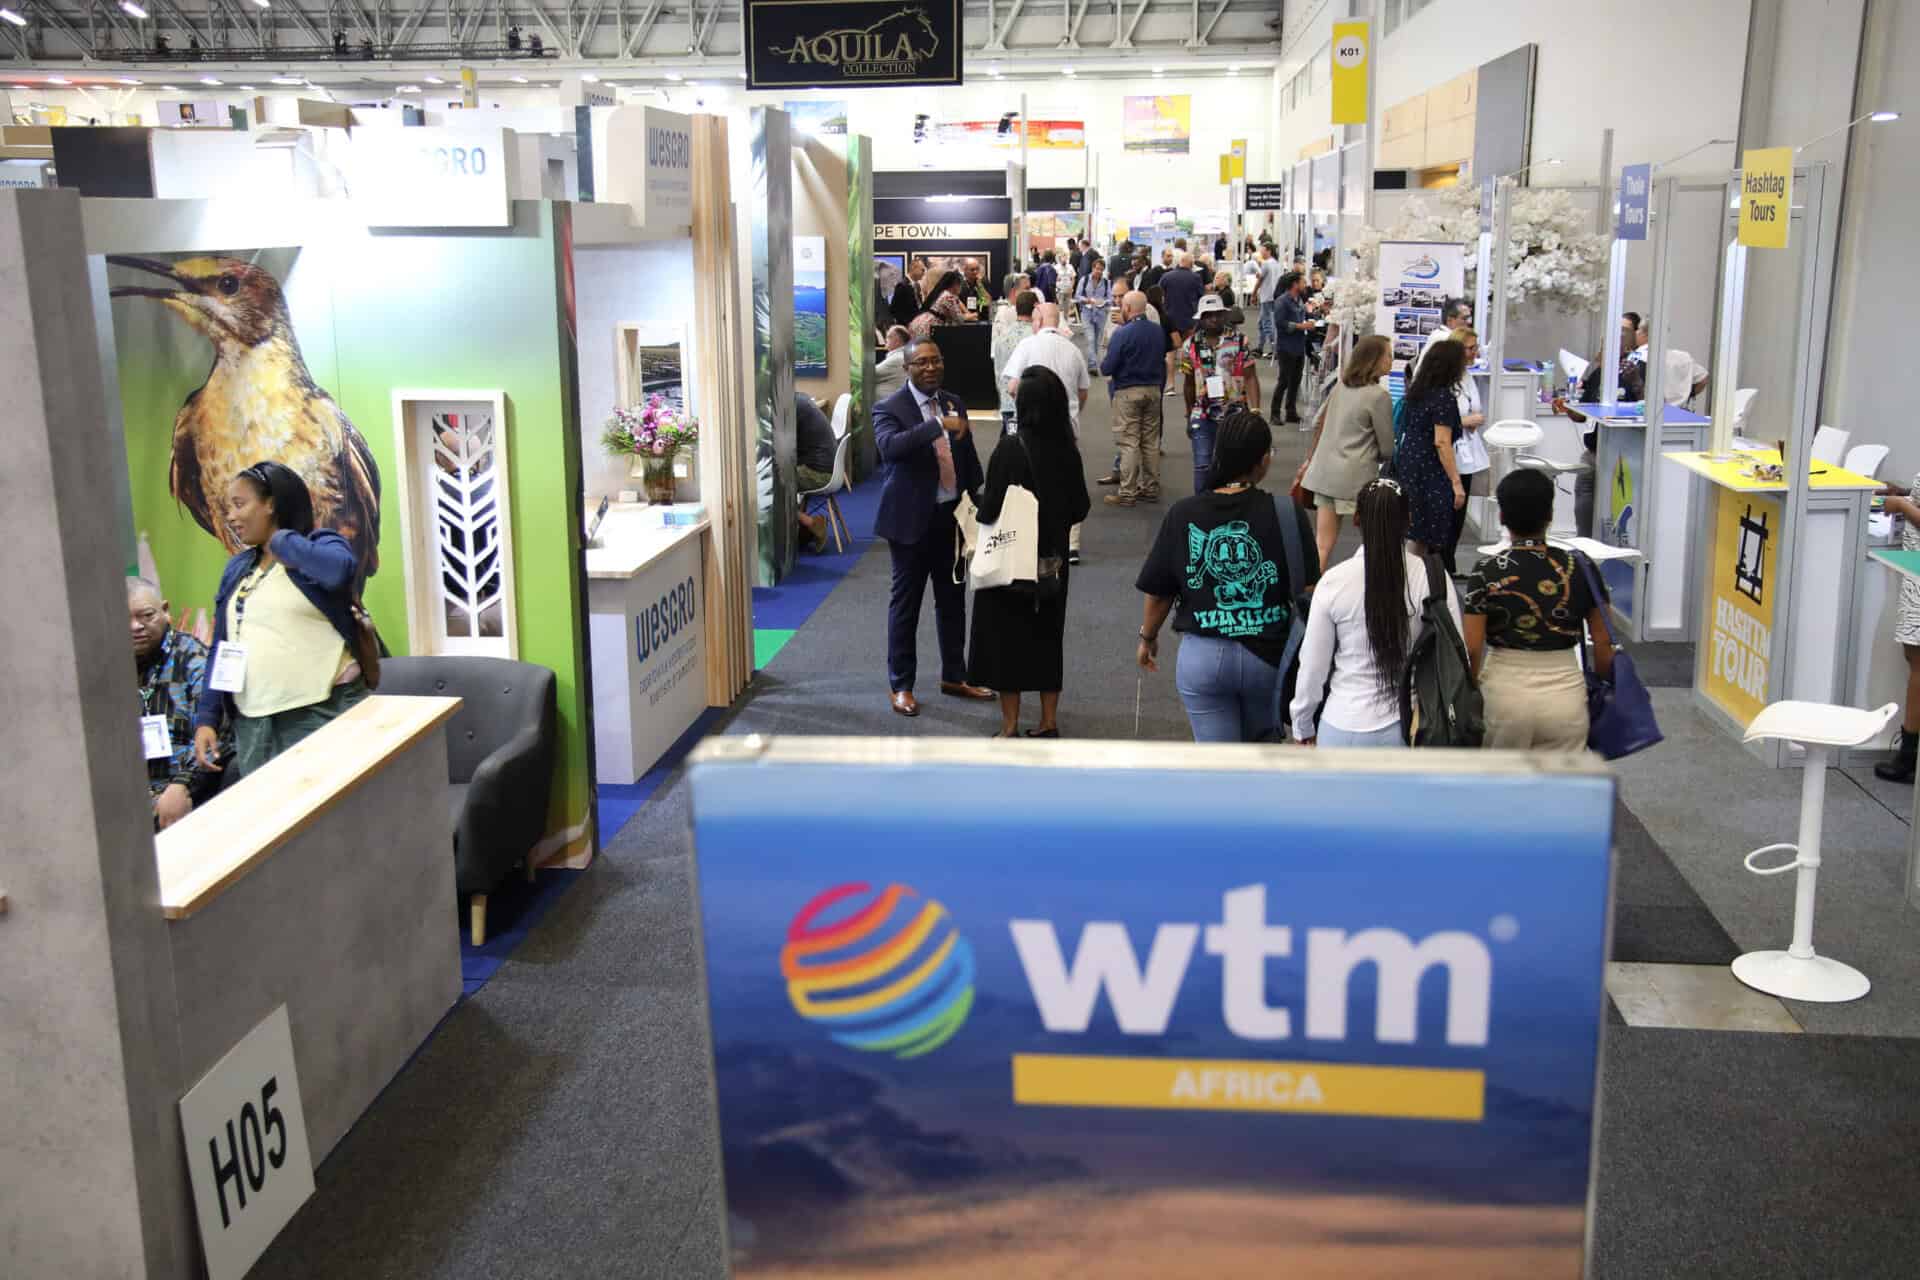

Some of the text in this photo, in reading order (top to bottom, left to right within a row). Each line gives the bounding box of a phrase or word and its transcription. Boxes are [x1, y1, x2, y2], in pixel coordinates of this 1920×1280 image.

[788, 32, 915, 66] AQUILA
[1340, 47, 1359, 57] K01
[842, 63, 916, 75] COLLECTION
[1745, 170, 1785, 199] Hashtag
[1624, 203, 1644, 225] Tours
[1750, 200, 1776, 223] Tours
[901, 225, 952, 238] TOWN.
[1193, 610, 1237, 629] IZZA
[1009, 882, 1492, 1048] wtm
[1171, 1069, 1326, 1103] AFRICA
[208, 1075, 287, 1230] H05
